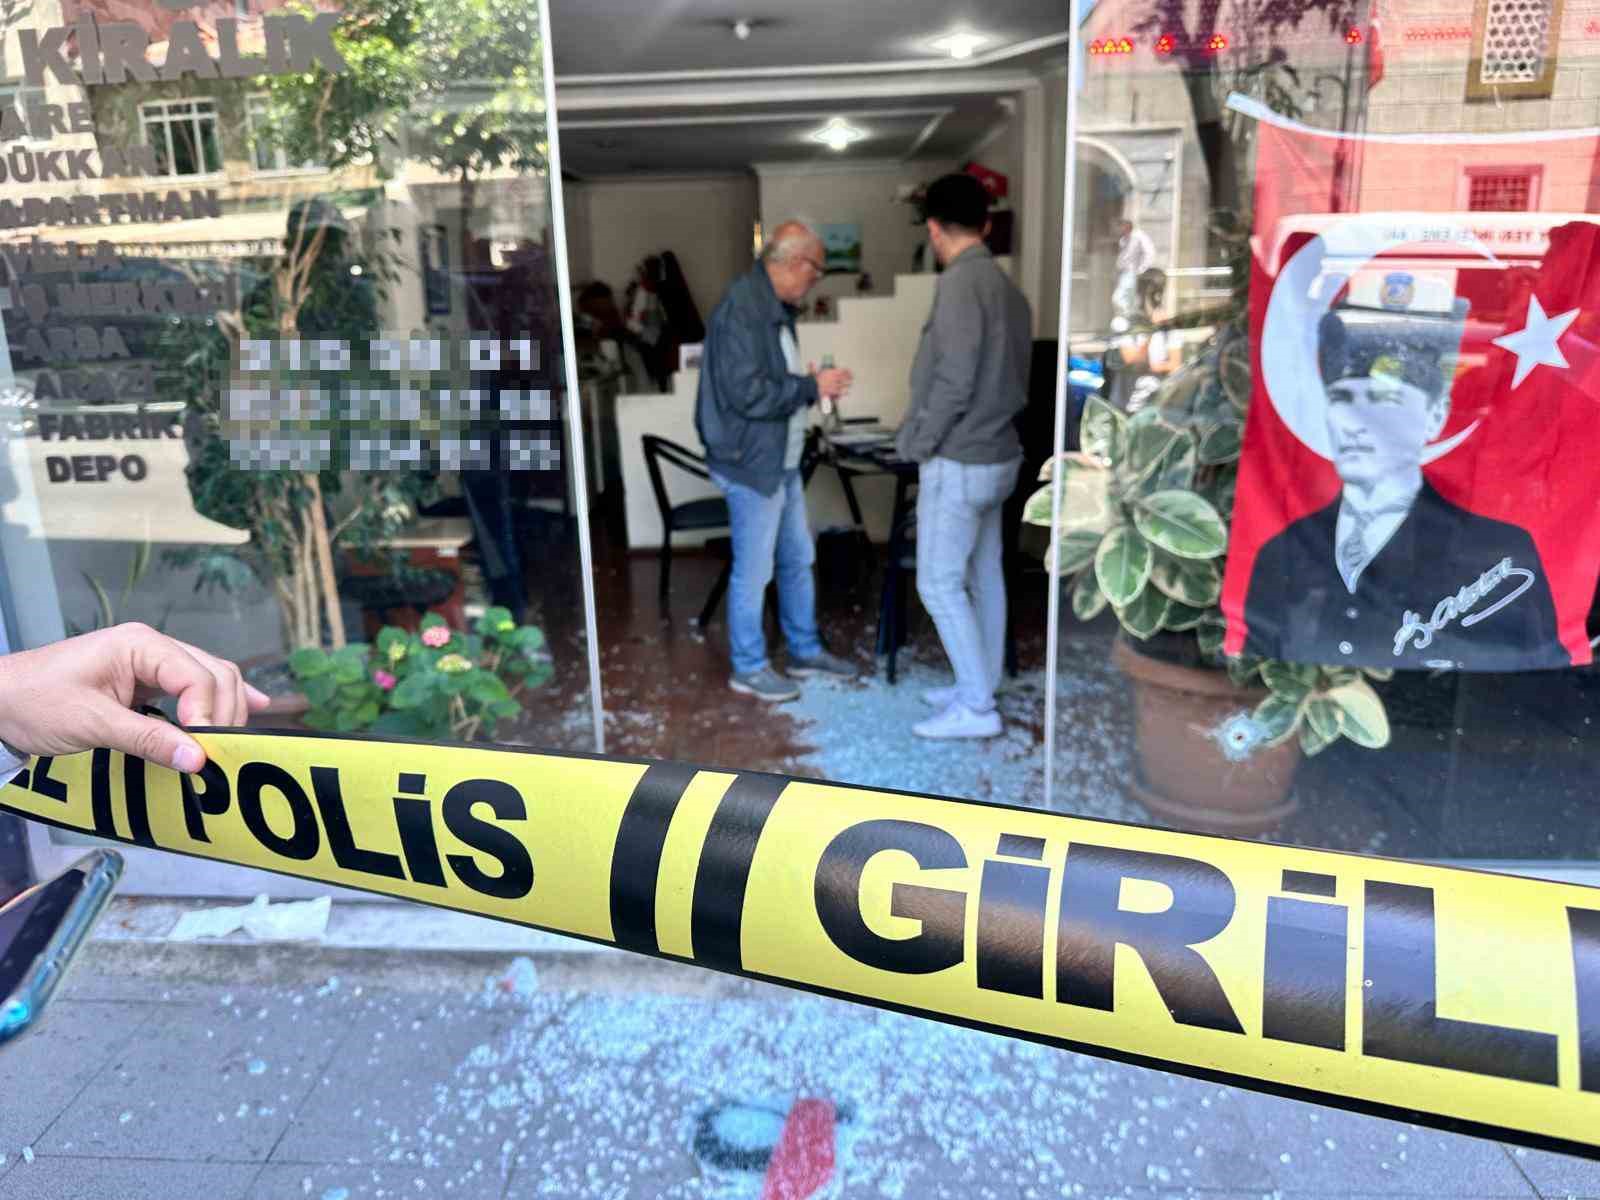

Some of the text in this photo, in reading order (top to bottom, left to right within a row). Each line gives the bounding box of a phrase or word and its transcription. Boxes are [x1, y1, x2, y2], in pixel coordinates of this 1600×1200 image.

[0, 145, 158, 183] ÜKKAN
[46, 454, 147, 482] DEPO
[813, 818, 1600, 1092] GİRİL
